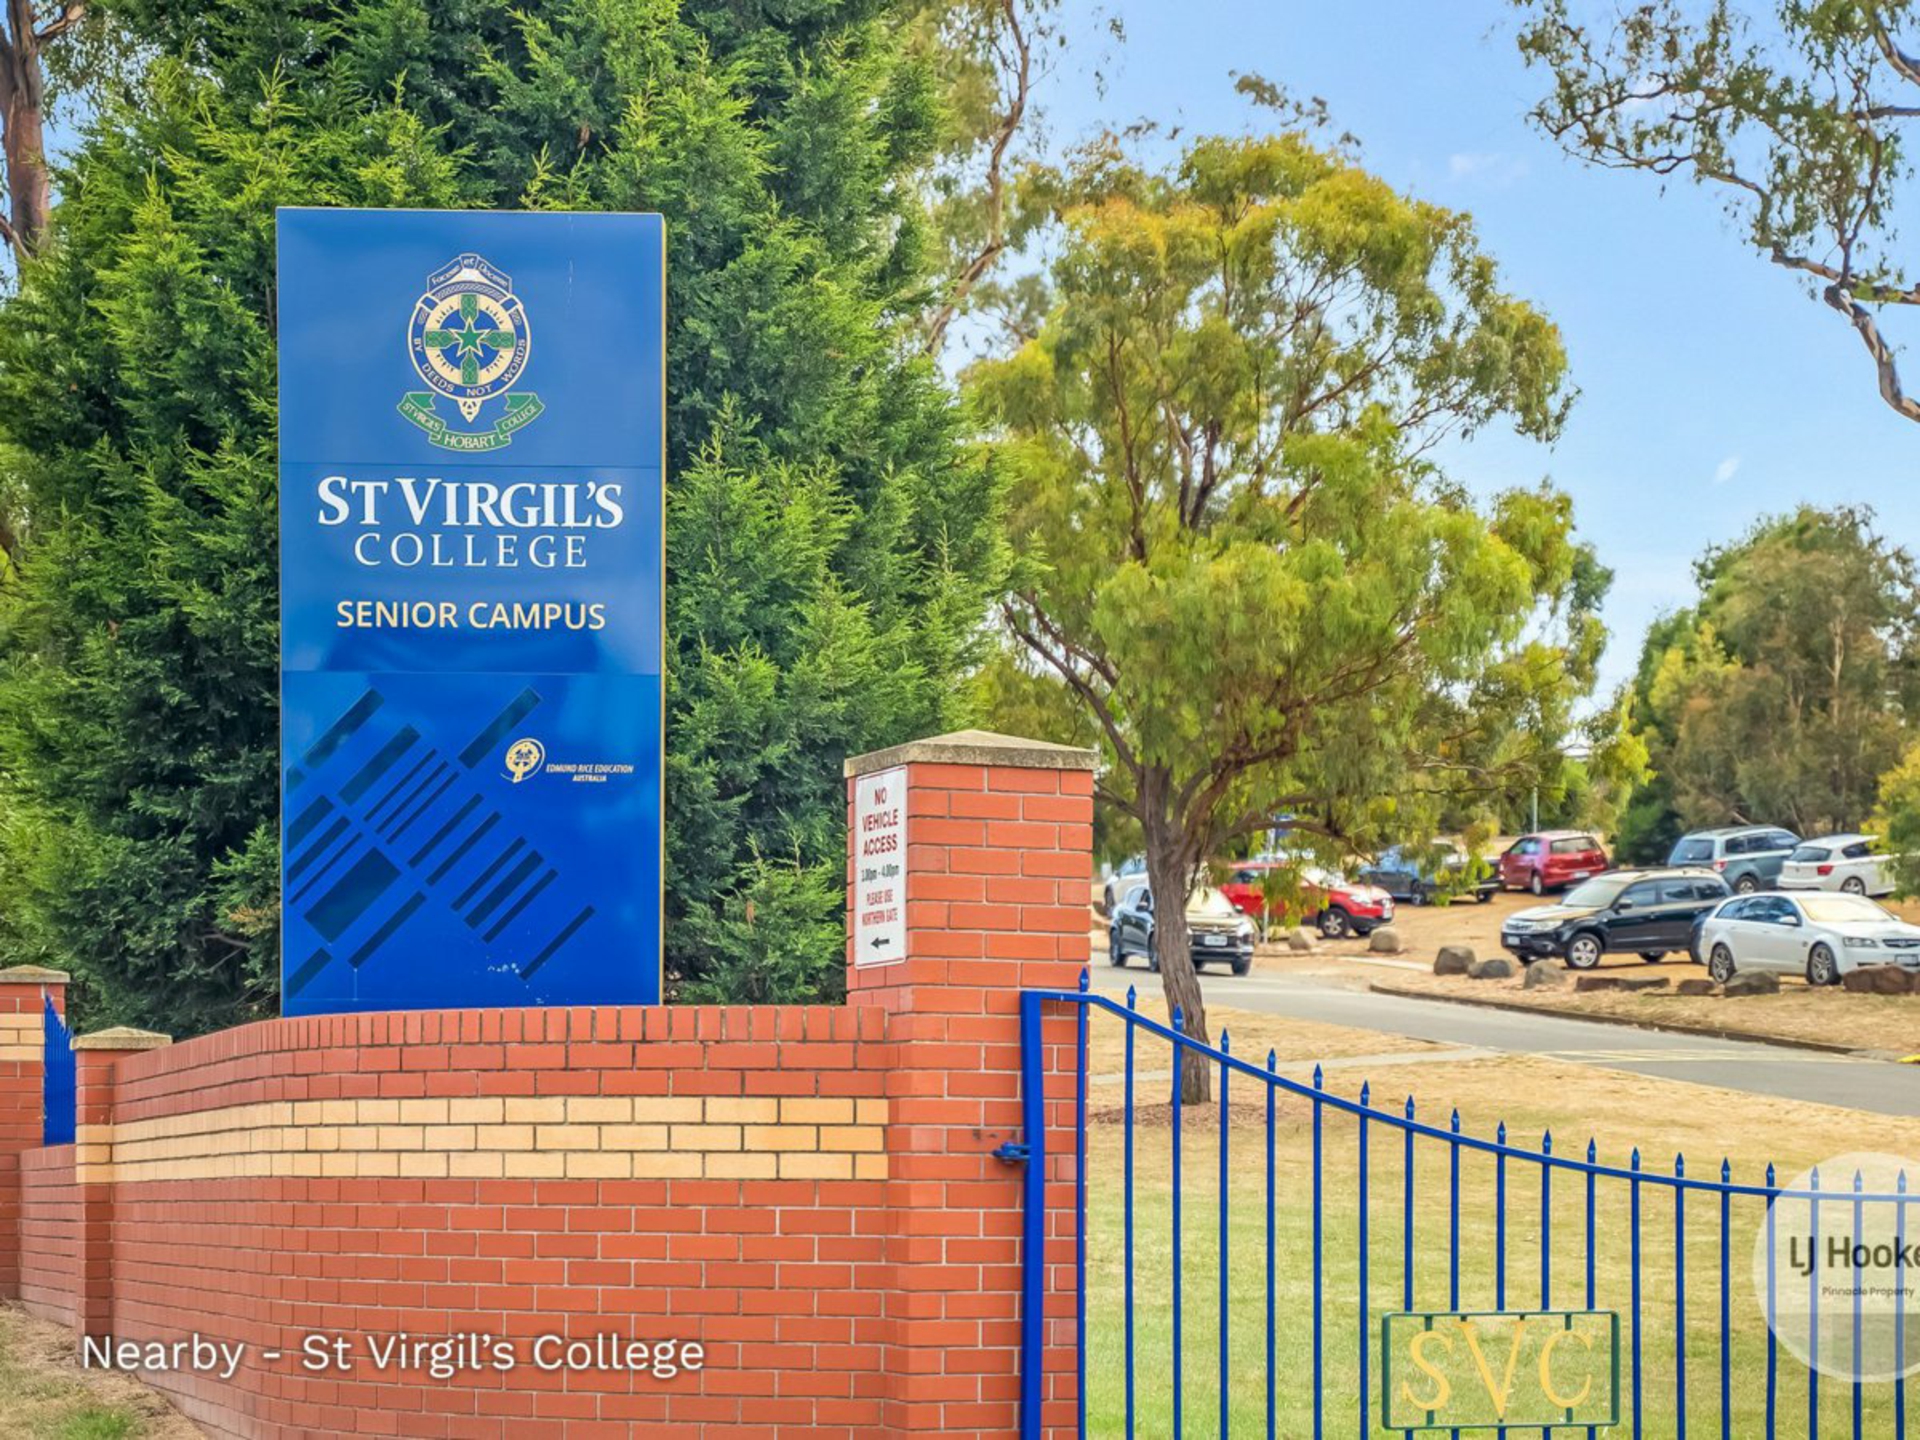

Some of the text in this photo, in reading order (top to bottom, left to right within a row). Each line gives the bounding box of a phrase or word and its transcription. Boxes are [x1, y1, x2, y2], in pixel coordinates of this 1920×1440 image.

[414, 337, 526, 397] BY DEEDS NOT WORDS
[501, 403, 538, 431] COLLEGE
[444, 433, 496, 449] HOBART
[317, 476, 624, 528] ST VIRGIL’S
[354, 533, 587, 568] COLLEGE
[336, 600, 606, 630] SENIOR CAMPUS
[572, 774, 607, 782] AUSTRALIA
[578, 763, 593, 773] RICE
[594, 763, 634, 773] EDUCATION
[874, 786, 887, 805] NO
[862, 808, 899, 832] VEHICLE
[862, 833, 898, 856] ACCESS
[1402, 1320, 1593, 1416] SVC
